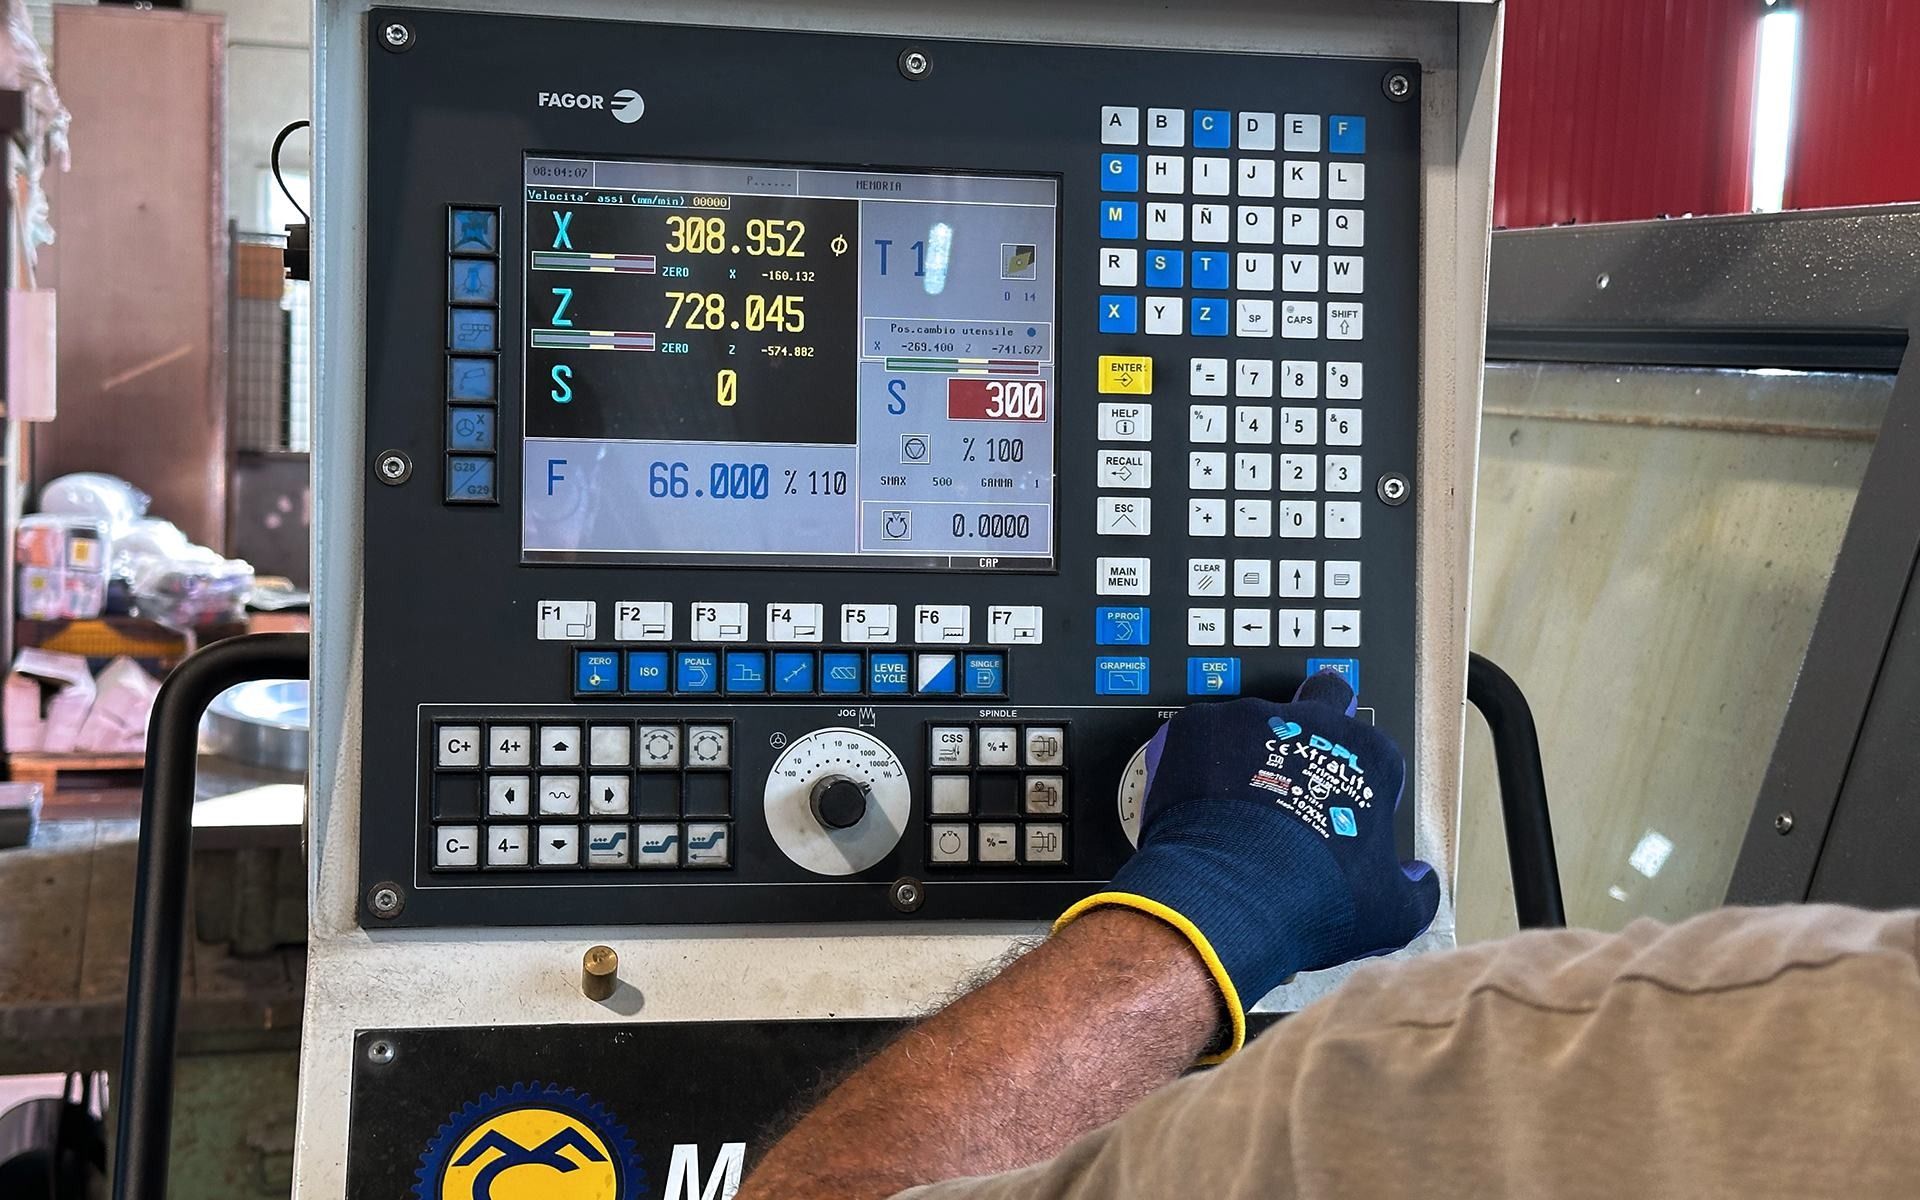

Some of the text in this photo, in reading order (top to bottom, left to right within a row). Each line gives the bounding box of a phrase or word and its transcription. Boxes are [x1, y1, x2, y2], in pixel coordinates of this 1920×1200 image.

[538, 92, 604, 110] FAGOR
[1109, 114, 1122, 126] A
[1157, 116, 1167, 128] B
[1202, 117, 1214, 130] C
[1247, 119, 1258, 132] D
[1293, 121, 1302, 134] E
[1338, 123, 1347, 135] F
[533, 166, 588, 178] 08:04:07
[1110, 160, 1122, 174] G
[1156, 163, 1166, 175] H
[1247, 166, 1255, 179] J
[1292, 168, 1303, 180] K
[1338, 169, 1347, 182] L
[856, 180, 902, 191] MEMORIA
[597, 195, 624, 204] assi
[631, 194, 685, 206] (mm/min)
[692, 197, 727, 208] 00000
[1109, 209, 1122, 221] M
[1155, 210, 1166, 222] N
[1201, 208, 1211, 224] Ñ
[1246, 212, 1258, 226] O
[1292, 215, 1302, 227] P
[1336, 216, 1348, 229] Q
[553, 211, 805, 257] X 308.952
[874, 240, 893, 275] T
[1109, 255, 1120, 268] R
[1155, 257, 1166, 270] S
[1201, 258, 1211, 271] T
[1246, 260, 1256, 272] U
[1291, 261, 1301, 274] V
[1335, 262, 1350, 275] W
[662, 266, 815, 282] ZERO X -160.132
[1024, 293, 1036, 301] 14
[552, 289, 805, 333] Z 728.045
[1108, 305, 1120, 318] X
[1154, 306, 1165, 319] Y
[1200, 308, 1211, 320] Z
[1331, 310, 1358, 318] SHIFT
[1287, 315, 1312, 324] CAPS
[890, 324, 1014, 336] Pos.cambio utensile
[662, 342, 689, 353] ZERO
[761, 346, 814, 357] -574.882
[875, 341, 881, 350] X
[902, 342, 954, 352] -269.400
[992, 345, 1043, 355] -741.677
[1111, 364, 1142, 372] ENTER
[1250, 373, 1258, 385] 7
[1295, 374, 1303, 386] 8
[1339, 374, 1348, 387] 9
[551, 365, 737, 406] S 0
[887, 379, 1043, 419] S 300
[476, 414, 485, 424] X
[1111, 409, 1138, 418] HELP
[1249, 419, 1258, 432] 4
[1295, 420, 1303, 432] 5
[1339, 421, 1348, 433] 6
[475, 431, 484, 441] Z
[986, 438, 1024, 462] 100
[454, 462, 476, 473] G28
[1106, 457, 1143, 466] RECALL
[1250, 466, 1256, 478] 1
[1294, 467, 1303, 479] 2
[1339, 467, 1348, 480] 3
[548, 459, 847, 500] F 66.000 % 110
[881, 476, 907, 486] SMAX
[932, 476, 952, 486] 500
[981, 477, 1013, 487] GAMMA
[467, 485, 490, 495] G29
[1114, 504, 1134, 513] ESC
[952, 513, 1029, 539] 0.0000
[1293, 514, 1302, 526] 0
[979, 558, 999, 568] CAP
[1194, 564, 1220, 572] CLEAR
[1110, 567, 1136, 576] MAIN
[1108, 577, 1138, 587] MENU
[541, 606, 561, 621] F1
[620, 606, 640, 621] F2
[696, 607, 716, 622] F3
[771, 608, 791, 623] F4
[845, 609, 865, 624] F5
[919, 610, 939, 625] F6
[992, 611, 1012, 626] F7
[1107, 612, 1140, 620] P.PROG
[1198, 623, 1215, 631] INS
[640, 667, 658, 676] ISO
[875, 664, 907, 673] LEVEL
[1100, 662, 1146, 670] GRAPHICS
[1202, 663, 1227, 672] EXEC
[875, 674, 907, 683] CYCLE
[837, 709, 856, 717] JOG
[979, 710, 1018, 718] SPINDLE
[942, 734, 963, 743] CSS
[448, 739, 471, 754] C+
[499, 739, 521, 753] 4+
[1309, 735, 1364, 774] DPL
[1292, 797, 1328, 827] 10/XXL
